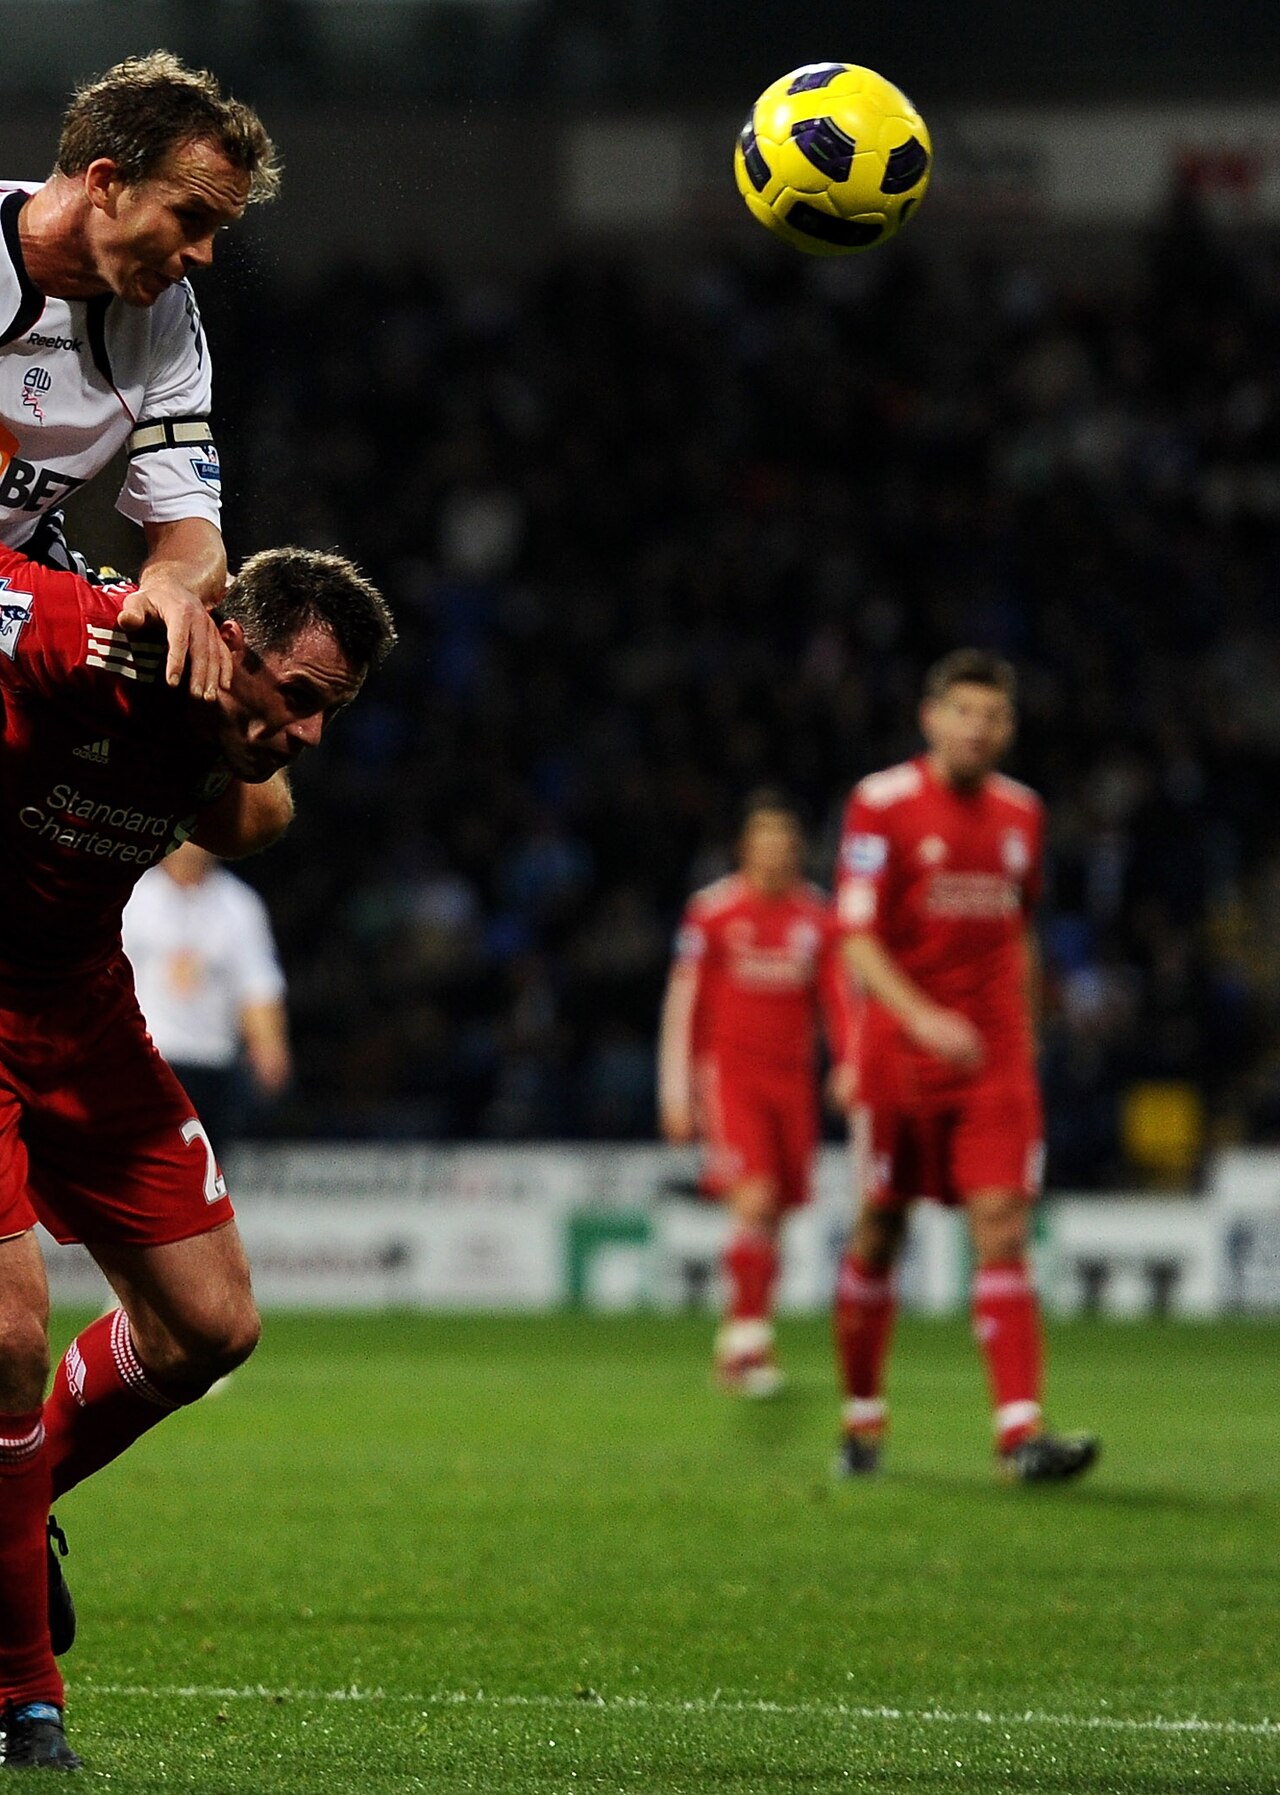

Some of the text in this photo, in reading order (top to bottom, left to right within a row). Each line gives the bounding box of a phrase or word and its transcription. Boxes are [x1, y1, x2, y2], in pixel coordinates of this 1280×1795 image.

[27, 333, 82, 353] Reebok
[19, 806, 160, 865] Chartered
[46, 784, 174, 836] Standard
